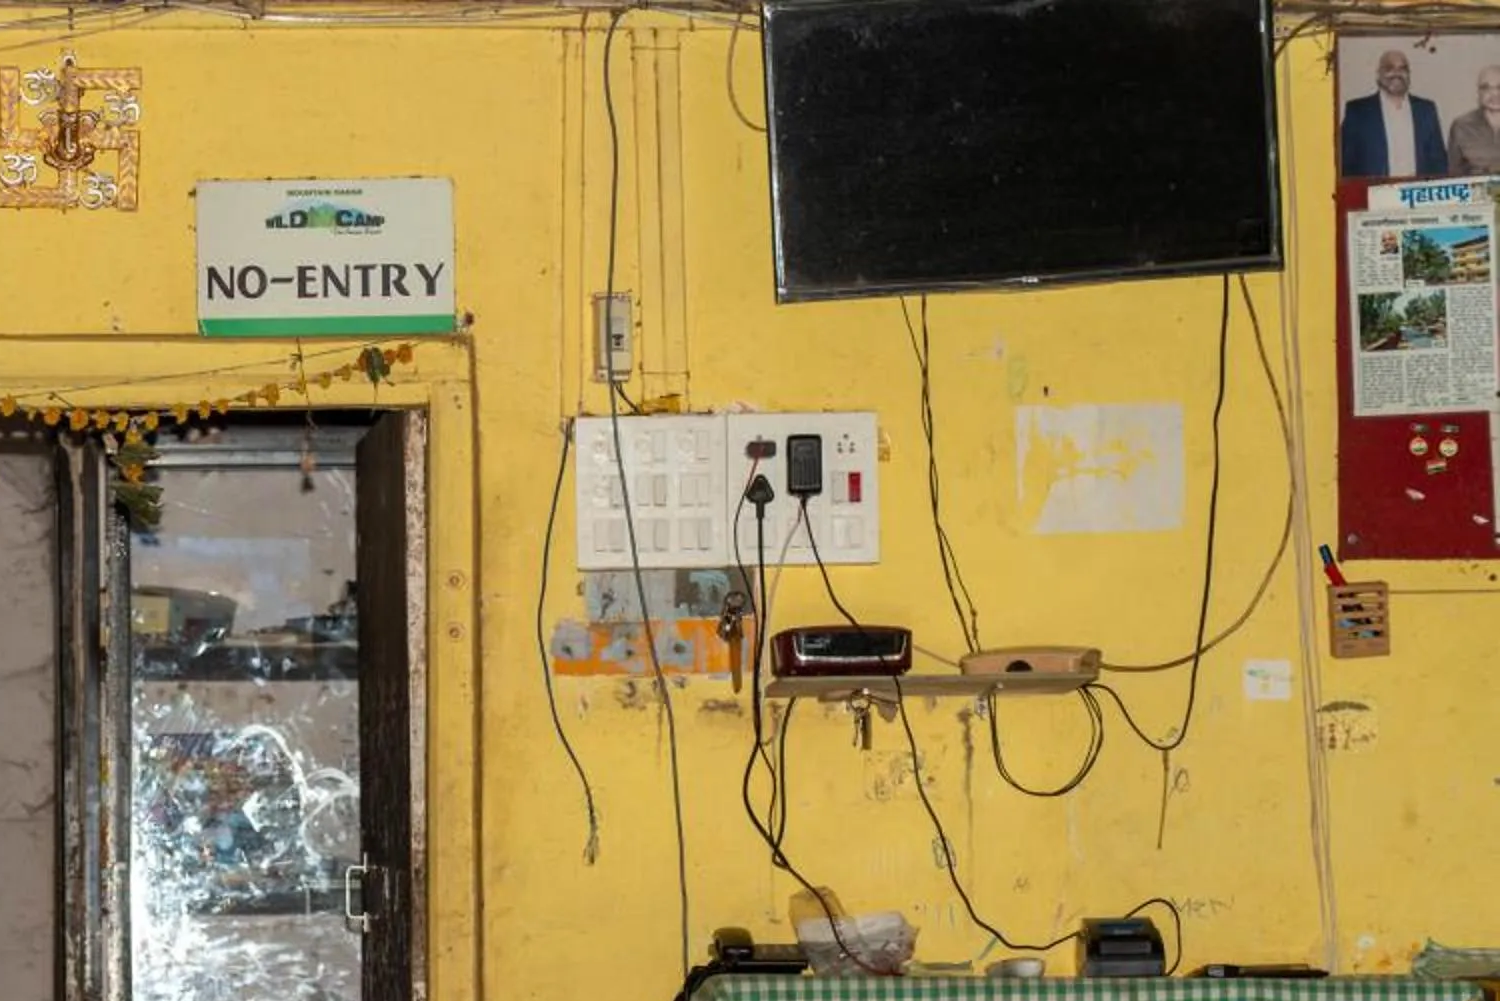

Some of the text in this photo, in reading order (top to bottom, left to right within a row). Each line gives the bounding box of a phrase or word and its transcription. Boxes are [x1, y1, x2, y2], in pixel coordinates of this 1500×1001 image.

[265, 209, 385, 229] WILD CAMP
[207, 263, 445, 300] NO-ENTRY
